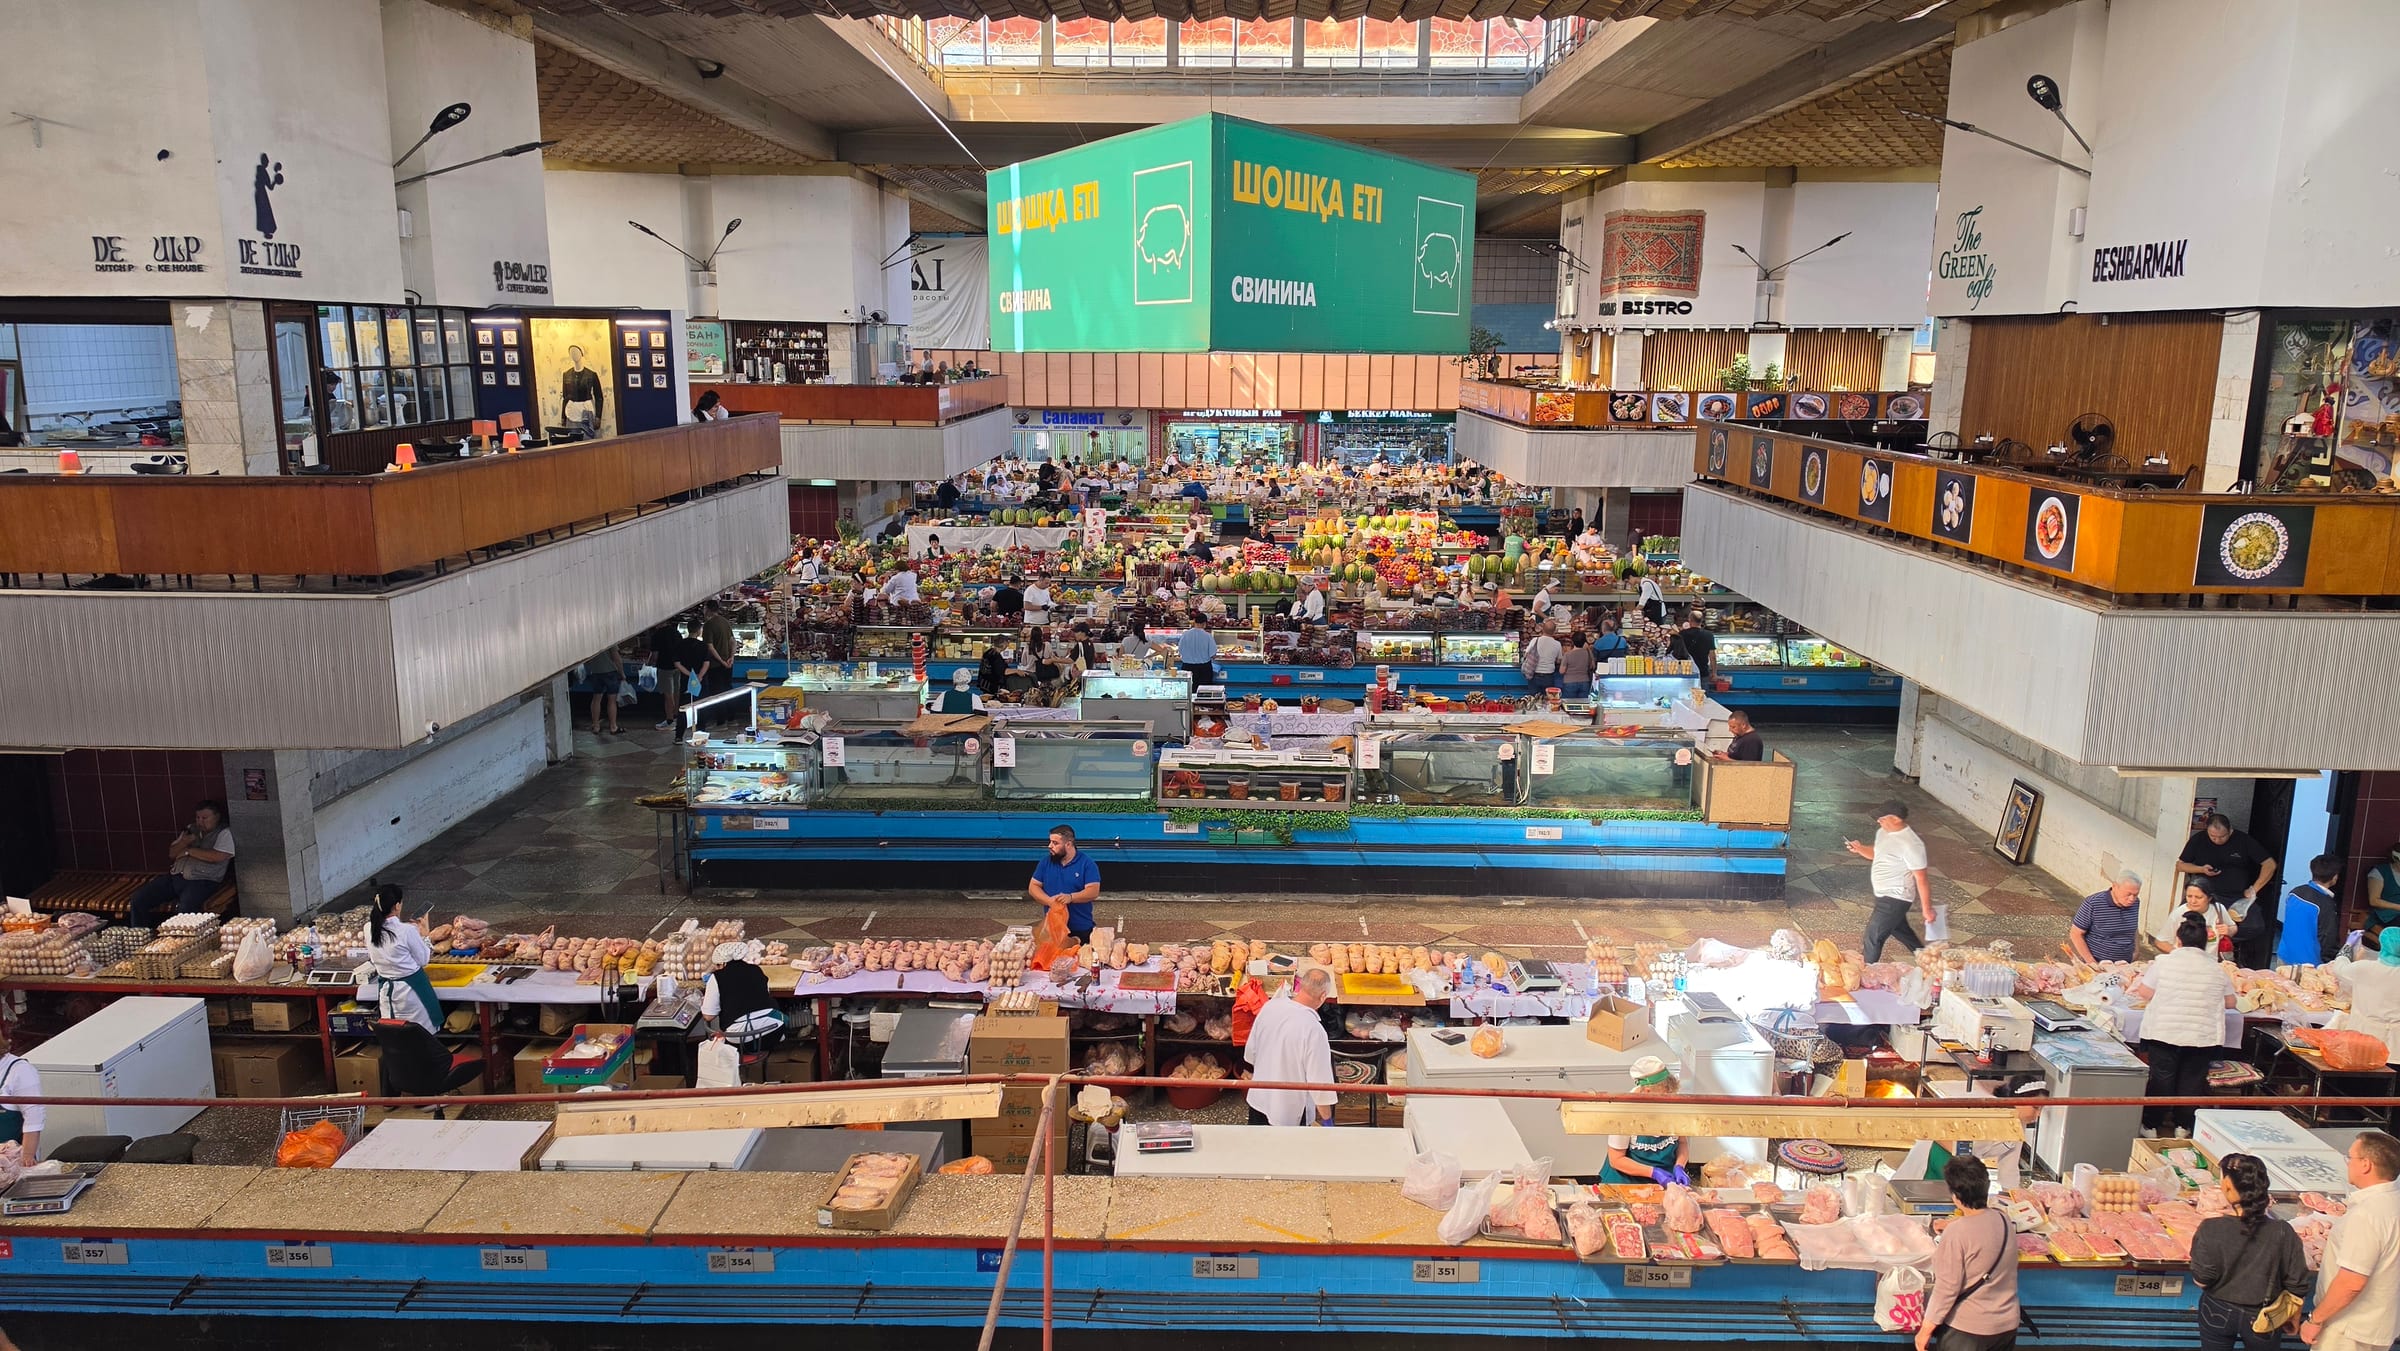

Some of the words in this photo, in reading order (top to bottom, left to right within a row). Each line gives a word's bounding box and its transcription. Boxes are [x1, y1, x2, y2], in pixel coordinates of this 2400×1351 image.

[1233, 160, 1344, 224] ШОШҚА
[1353, 183, 1383, 224] ЕТІ
[997, 188, 1068, 235] ШОШҚА
[1073, 180, 1099, 222] ЕТІ
[1953, 205, 1983, 253] The
[92, 236, 125, 262] DE
[239, 238, 258, 265] DE
[95, 264, 126, 272] DUTCH
[172, 264, 204, 272] HOUSE
[1939, 251, 1987, 279] GREEN
[2092, 239, 2188, 282] BESHBARMAK
[504, 261, 547, 282] BOWLER
[1231, 275, 1316, 307] СВИНИНА
[1967, 263, 1996, 311] café
[999, 288, 1052, 313] СВИНИНА
[1622, 301, 1693, 315] BISTRO
[1042, 409, 1104, 425] Саламат
[85, 1249, 104, 1258] 357
[288, 1252, 309, 1261] 356
[504, 1255, 524, 1264] 355
[731, 1258, 751, 1266] 354
[1216, 1263, 1236, 1272] 352
[1437, 1267, 1455, 1276] 351
[1647, 1272, 1669, 1281] 350
[2139, 1281, 2160, 1290] 348
